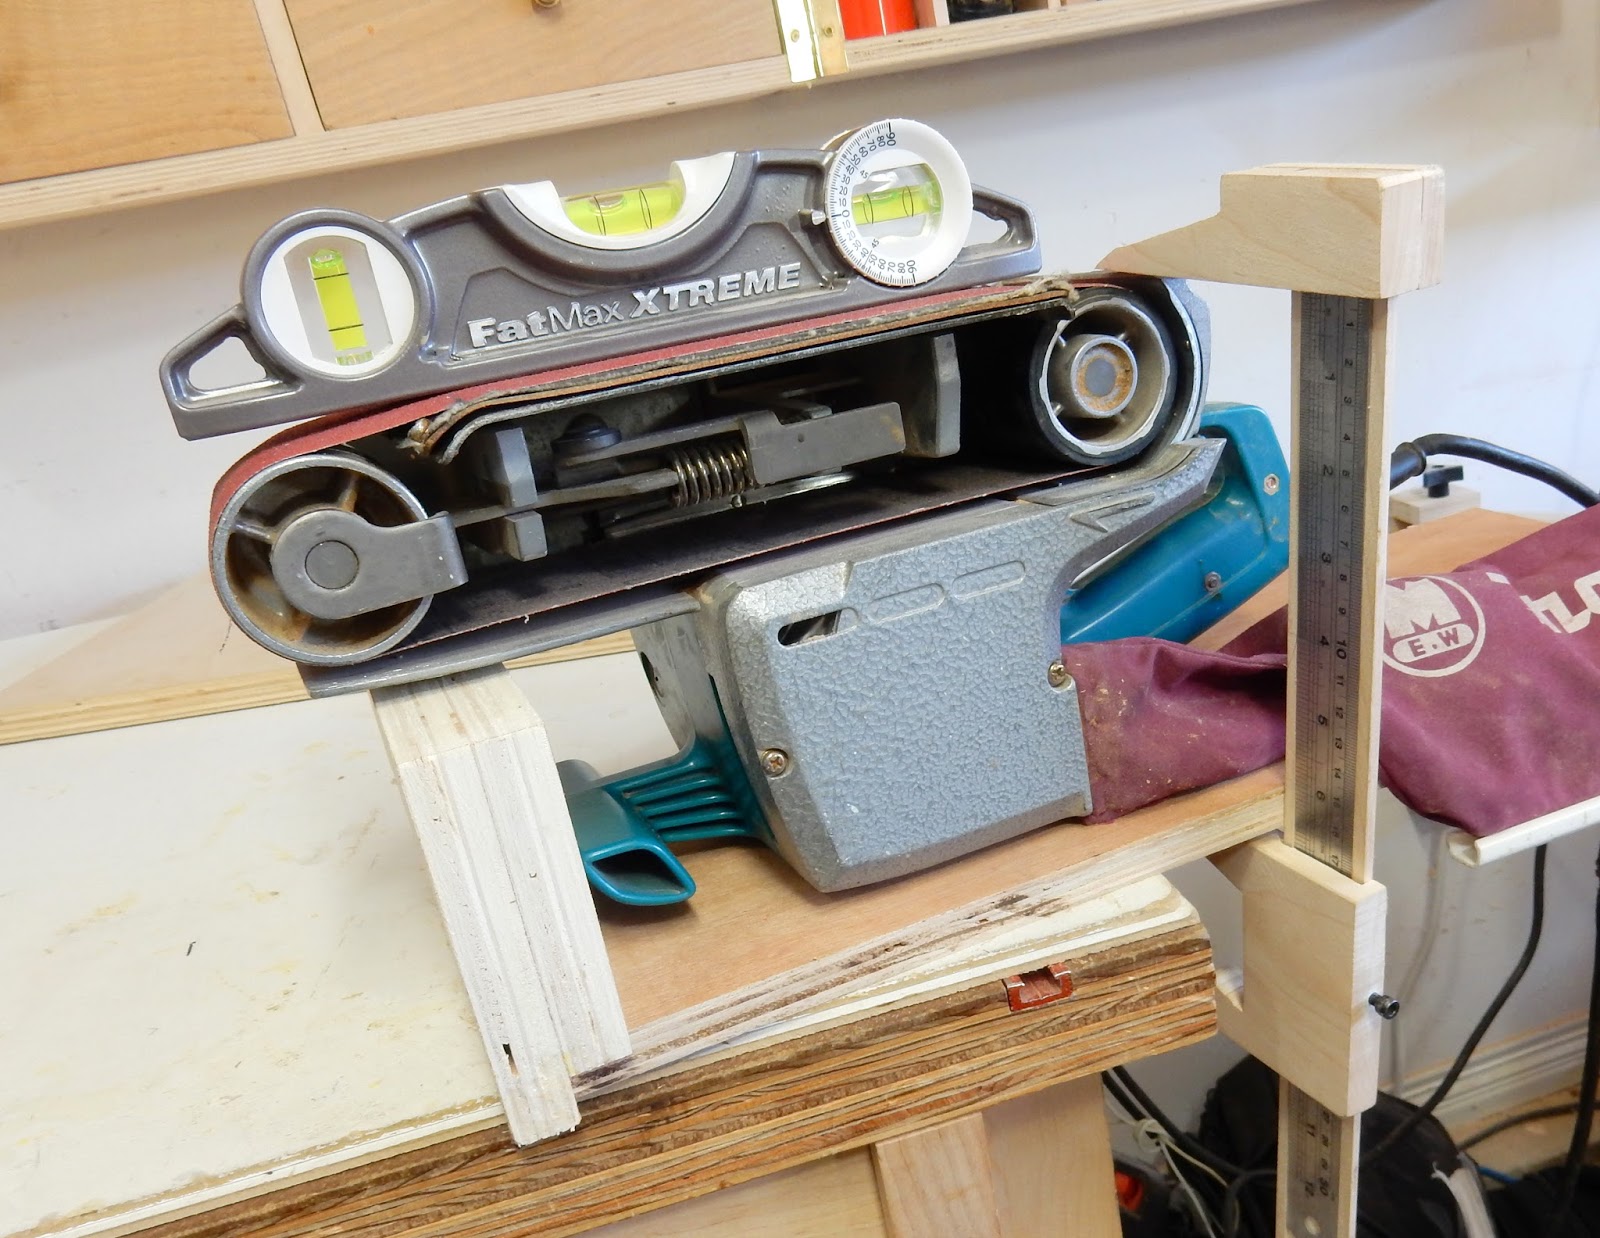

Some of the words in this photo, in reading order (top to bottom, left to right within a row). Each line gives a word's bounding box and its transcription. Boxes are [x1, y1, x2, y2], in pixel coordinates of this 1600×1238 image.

[867, 139, 877, 152] 70
[876, 135, 886, 148] 80
[886, 132, 897, 147] 90
[858, 146, 869, 158] 60
[850, 153, 861, 166] 50
[845, 164, 855, 176] 40
[859, 169, 869, 179] 45
[841, 174, 851, 185] 30
[839, 185, 848, 196] 20
[839, 198, 847, 207] 10
[841, 209, 850, 218] 0
[842, 219, 851, 230] 10
[846, 229, 856, 242] 20
[852, 239, 862, 251] 30
[871, 238, 880, 249] 45
[860, 247, 869, 258] 40
[868, 254, 878, 266] 50
[877, 258, 887, 270] 60
[887, 261, 896, 273] 70
[897, 262, 906, 274] 80
[906, 259, 917, 274] 90
[466, 301, 624, 348] FatMax
[628, 262, 801, 319] XTREME
[1322, 464, 1334, 477] 2
[1321, 552, 1332, 565] 3
[1320, 635, 1329, 647] 4
[1336, 640, 1347, 660] 10
[1336, 675, 1344, 687] 11
[1335, 707, 1344, 719] 12
[1334, 738, 1342, 750] 13
[1333, 767, 1341, 779] 14
[1316, 790, 1326, 801] 6
[1331, 854, 1339, 867] 17
